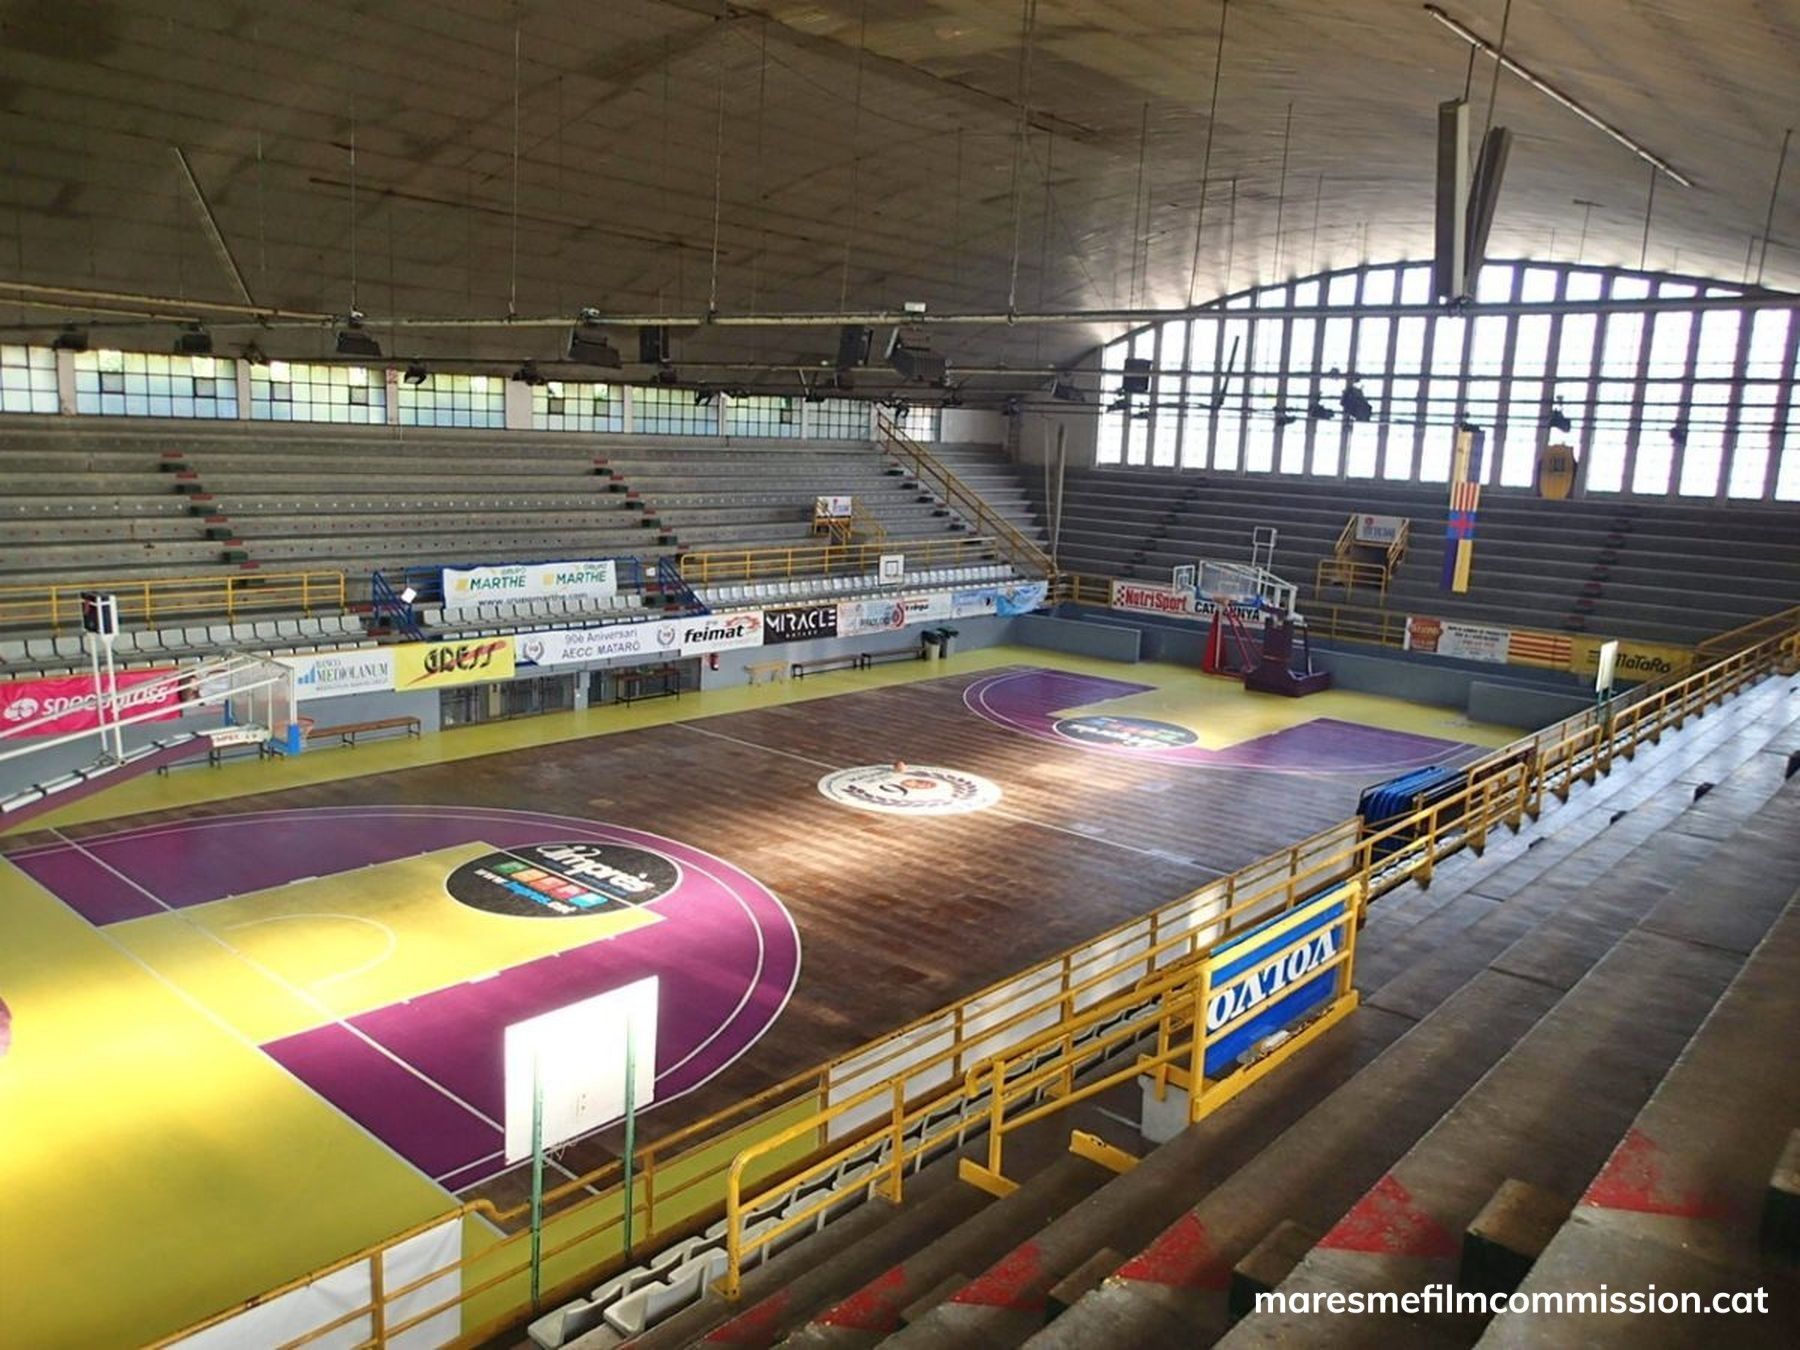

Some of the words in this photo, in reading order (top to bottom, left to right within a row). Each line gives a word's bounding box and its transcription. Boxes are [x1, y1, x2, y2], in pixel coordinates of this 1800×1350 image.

[470, 575, 526, 590] MARTHE
[556, 570, 607, 585] MARTHE
[766, 609, 836, 633] MIRACLE
[684, 624, 744, 644] feimat
[562, 646, 592, 660] AECC
[1206, 930, 1337, 1031] VOLVO
